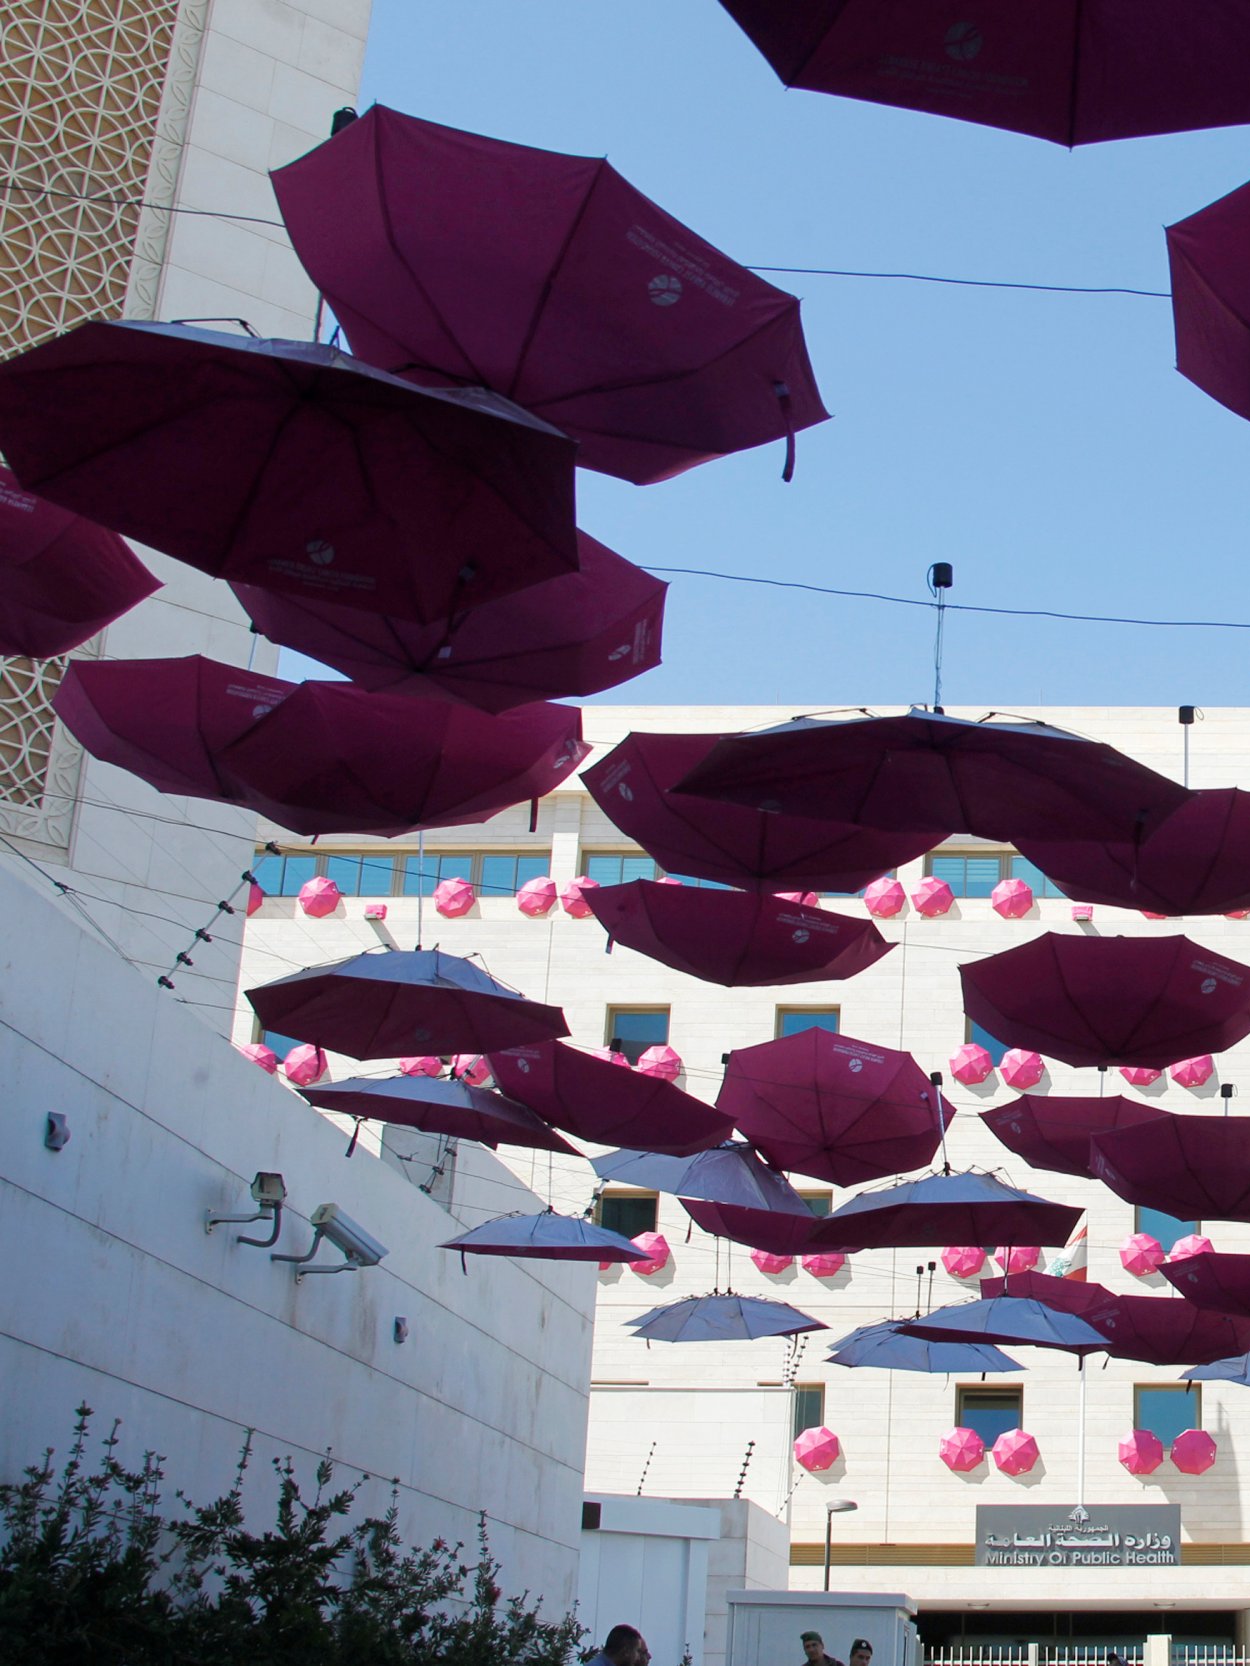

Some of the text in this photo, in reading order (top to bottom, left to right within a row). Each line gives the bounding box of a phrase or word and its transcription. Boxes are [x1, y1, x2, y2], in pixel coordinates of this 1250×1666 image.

[1055, 1532, 1120, 1547] الصحة
[985, 1551, 1043, 1566] Ministry
[1072, 1551, 1120, 1565] Public
[1126, 1551, 1174, 1564] Health
